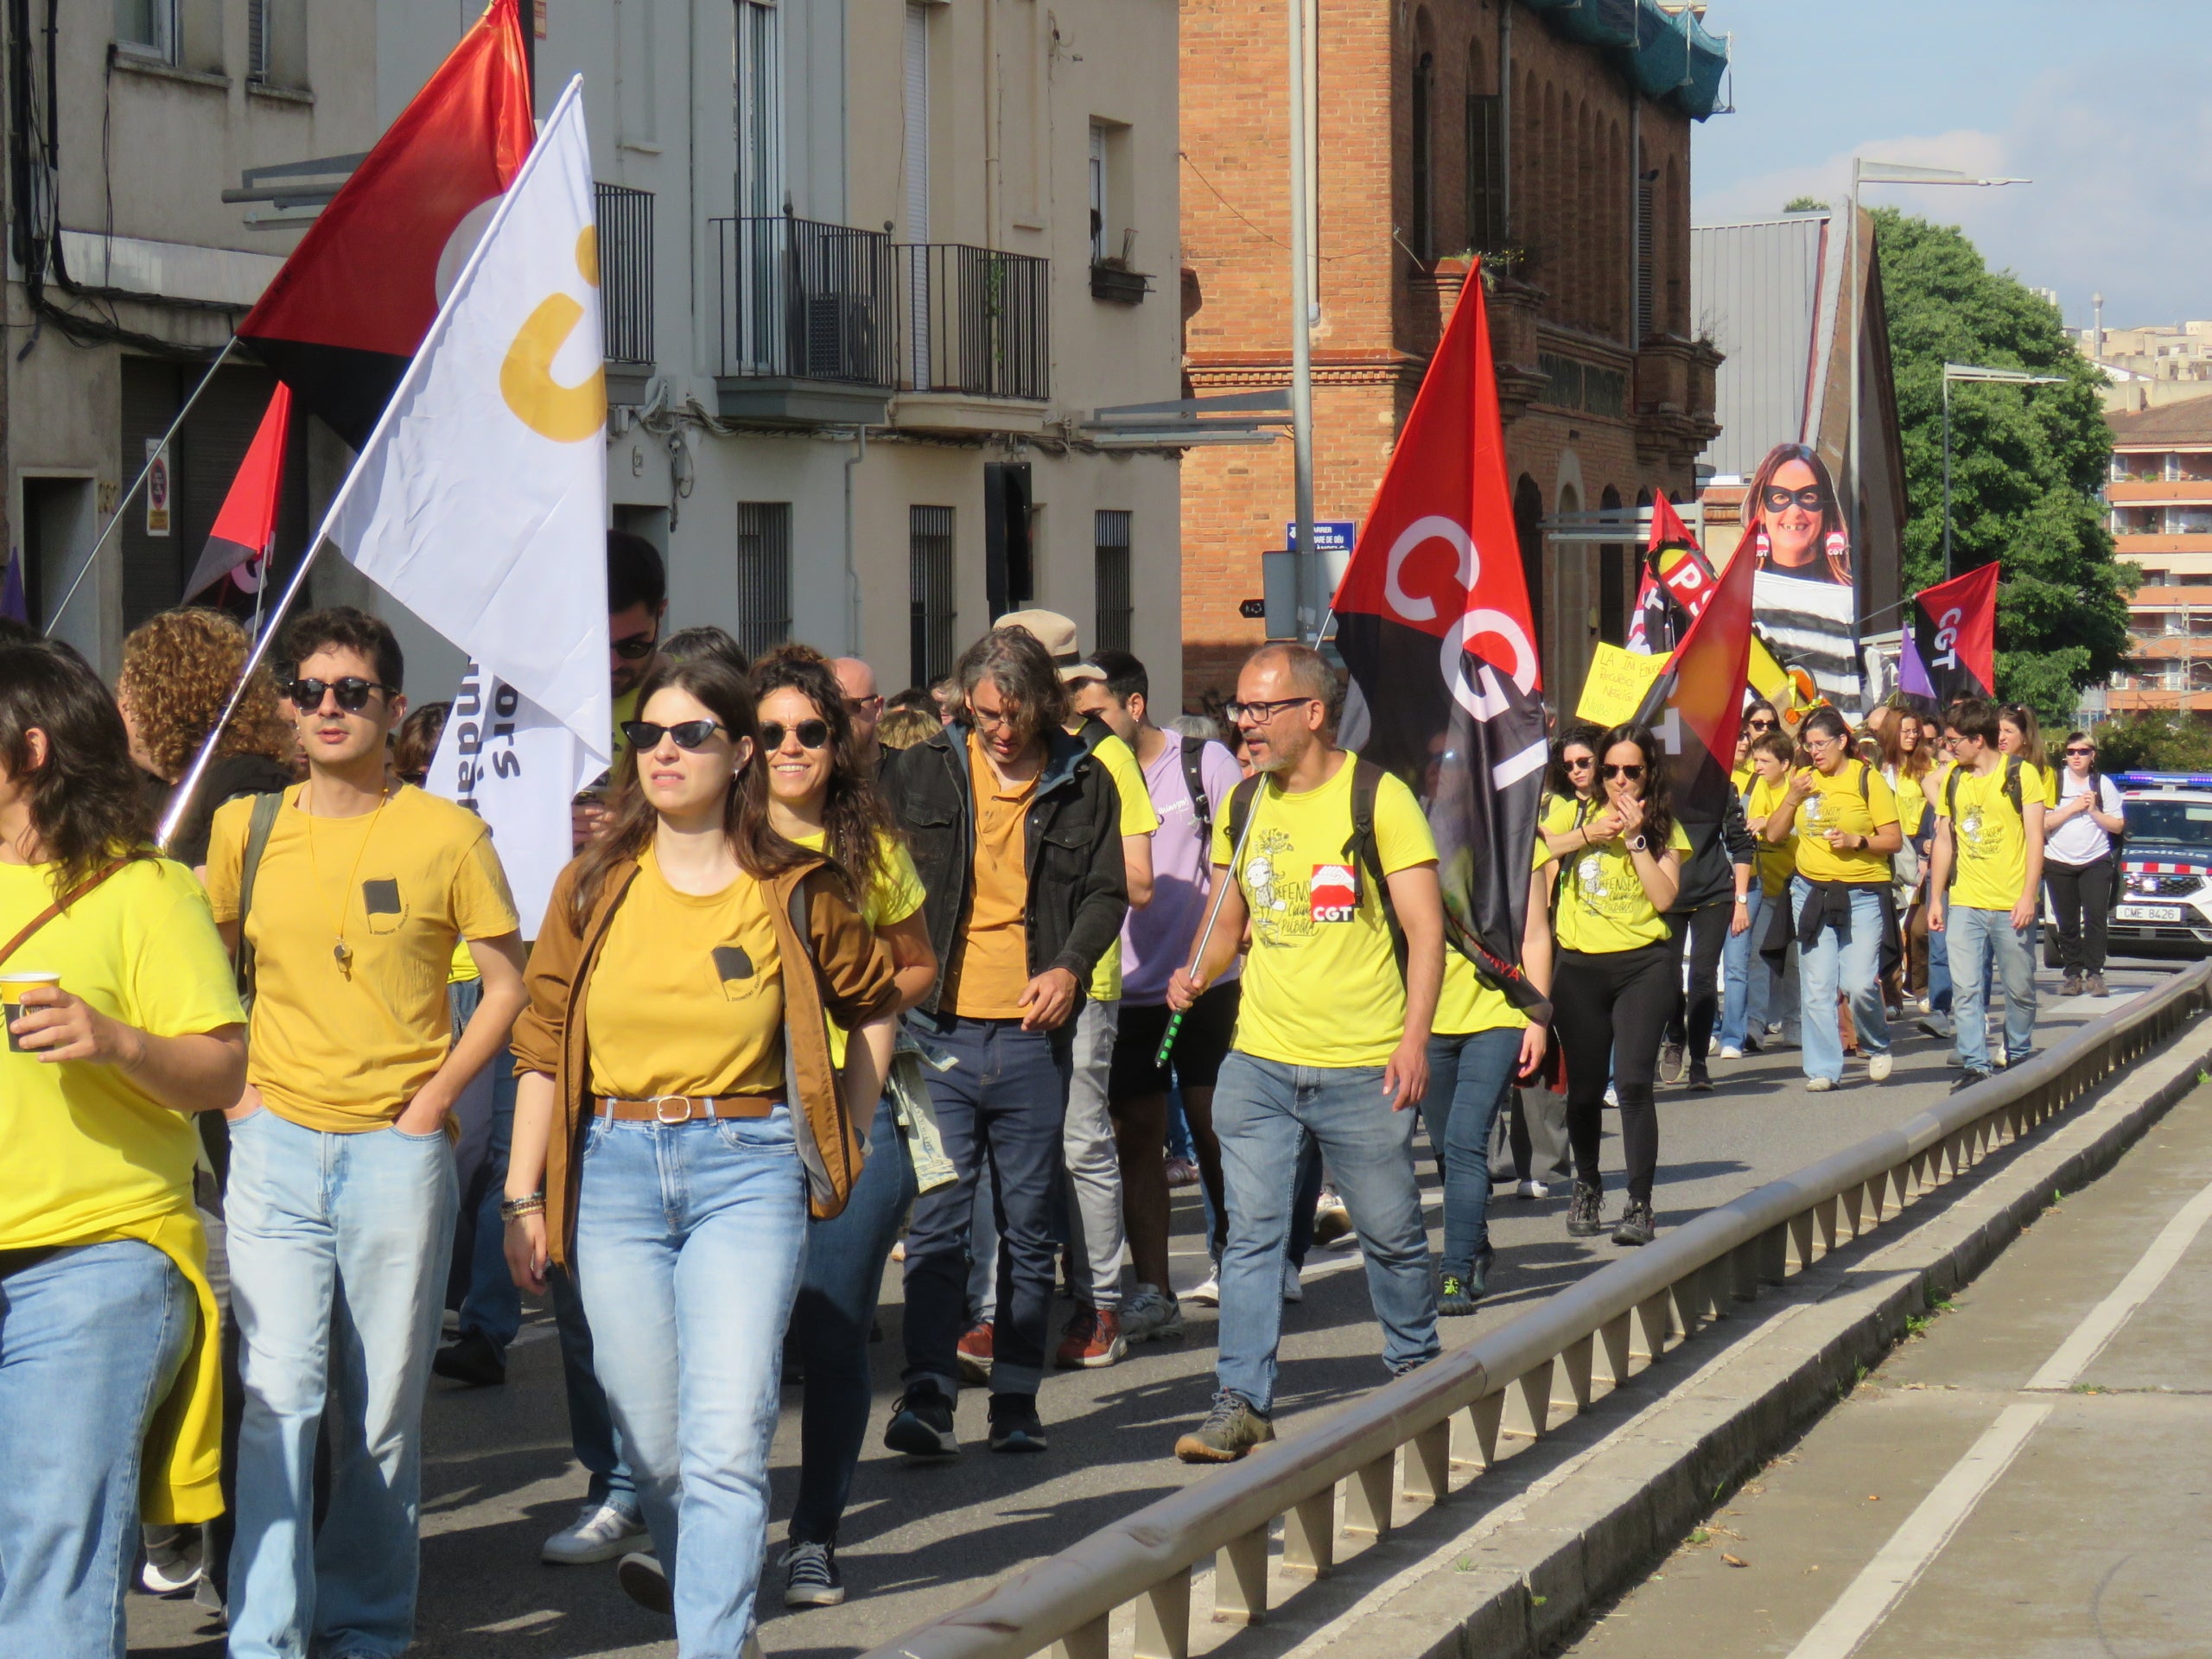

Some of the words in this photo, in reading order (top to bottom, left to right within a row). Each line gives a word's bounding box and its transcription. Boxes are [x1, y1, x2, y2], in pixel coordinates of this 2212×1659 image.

[1931, 607, 1961, 671] CGT
[2128, 849, 2209, 859] policia
[1274, 880, 1311, 903] DEFENS
[1313, 906, 1352, 921] CGT
[2124, 908, 2143, 918] CME
[2148, 909, 2175, 919] 8426
